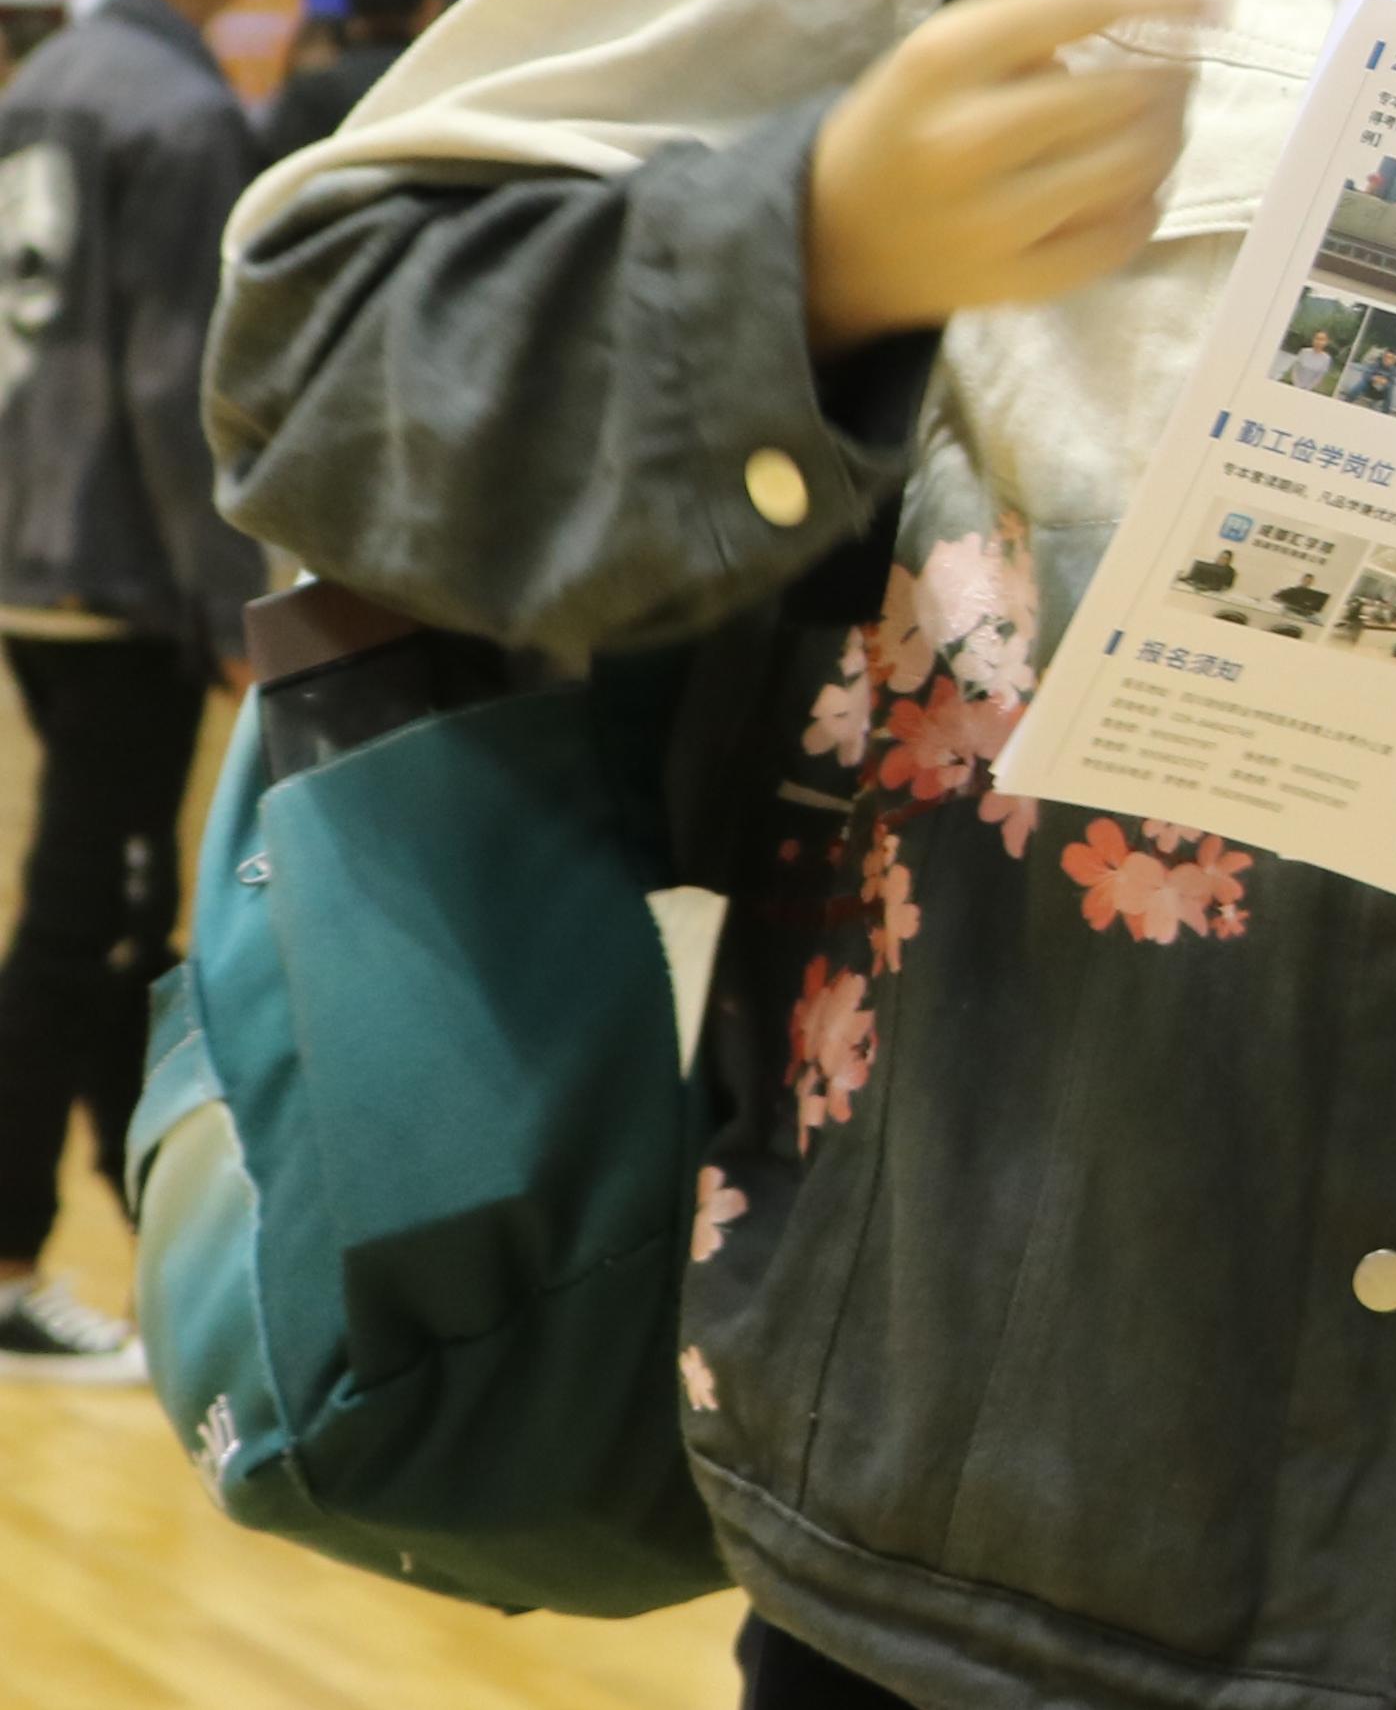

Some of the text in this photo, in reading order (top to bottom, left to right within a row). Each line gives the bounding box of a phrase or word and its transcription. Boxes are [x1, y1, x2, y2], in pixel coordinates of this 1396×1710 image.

[1236, 418, 1396, 487] 勤工俭学岗位
[1135, 639, 1244, 682] 报名须知
